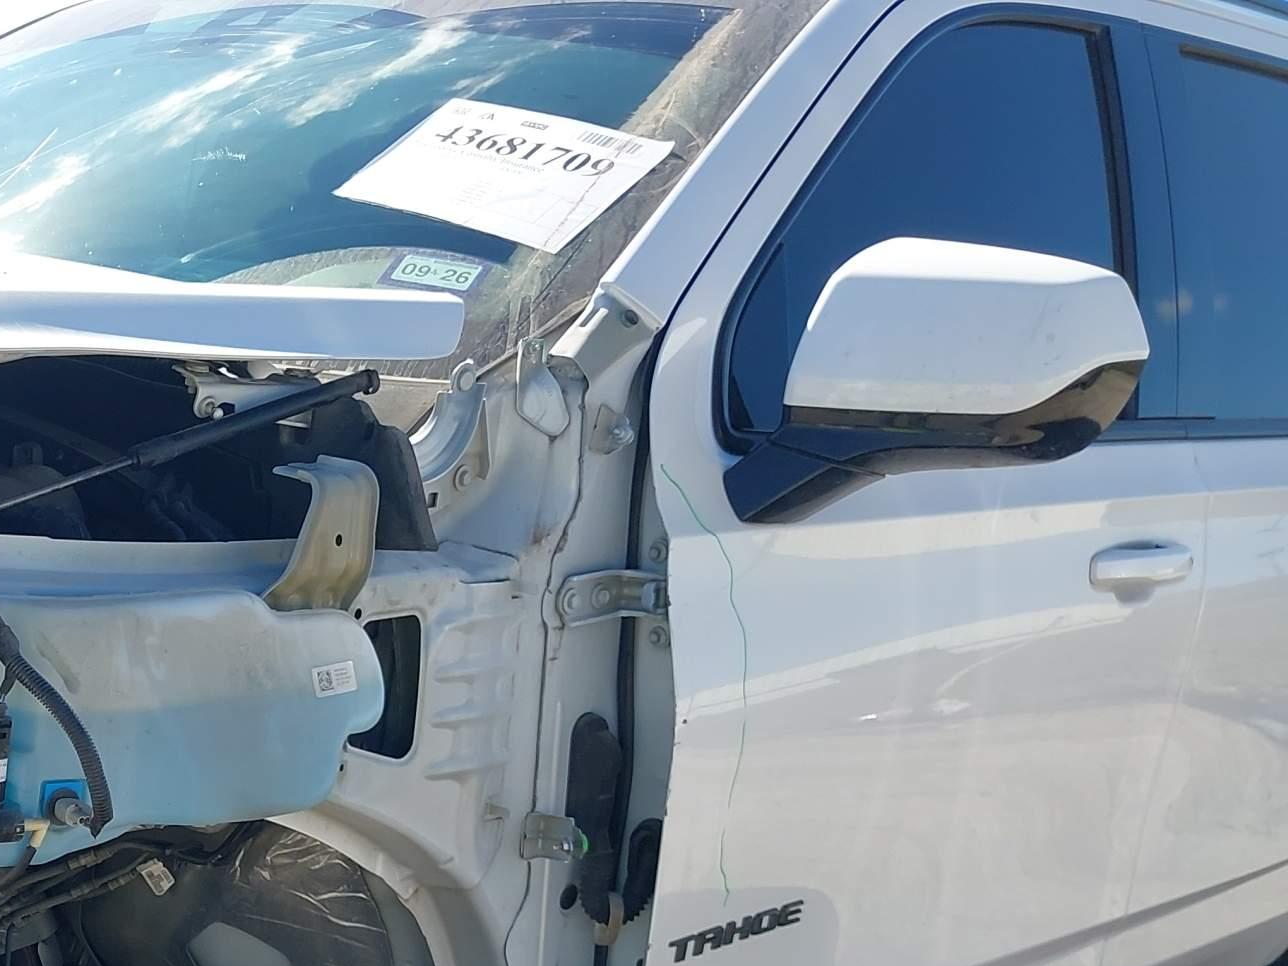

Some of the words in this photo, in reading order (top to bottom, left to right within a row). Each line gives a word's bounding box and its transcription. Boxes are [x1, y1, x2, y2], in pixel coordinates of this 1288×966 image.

[435, 126, 615, 177] 43681709
[401, 263, 431, 277] 09
[439, 269, 472, 284] 26
[668, 899, 804, 963] TAHOE
